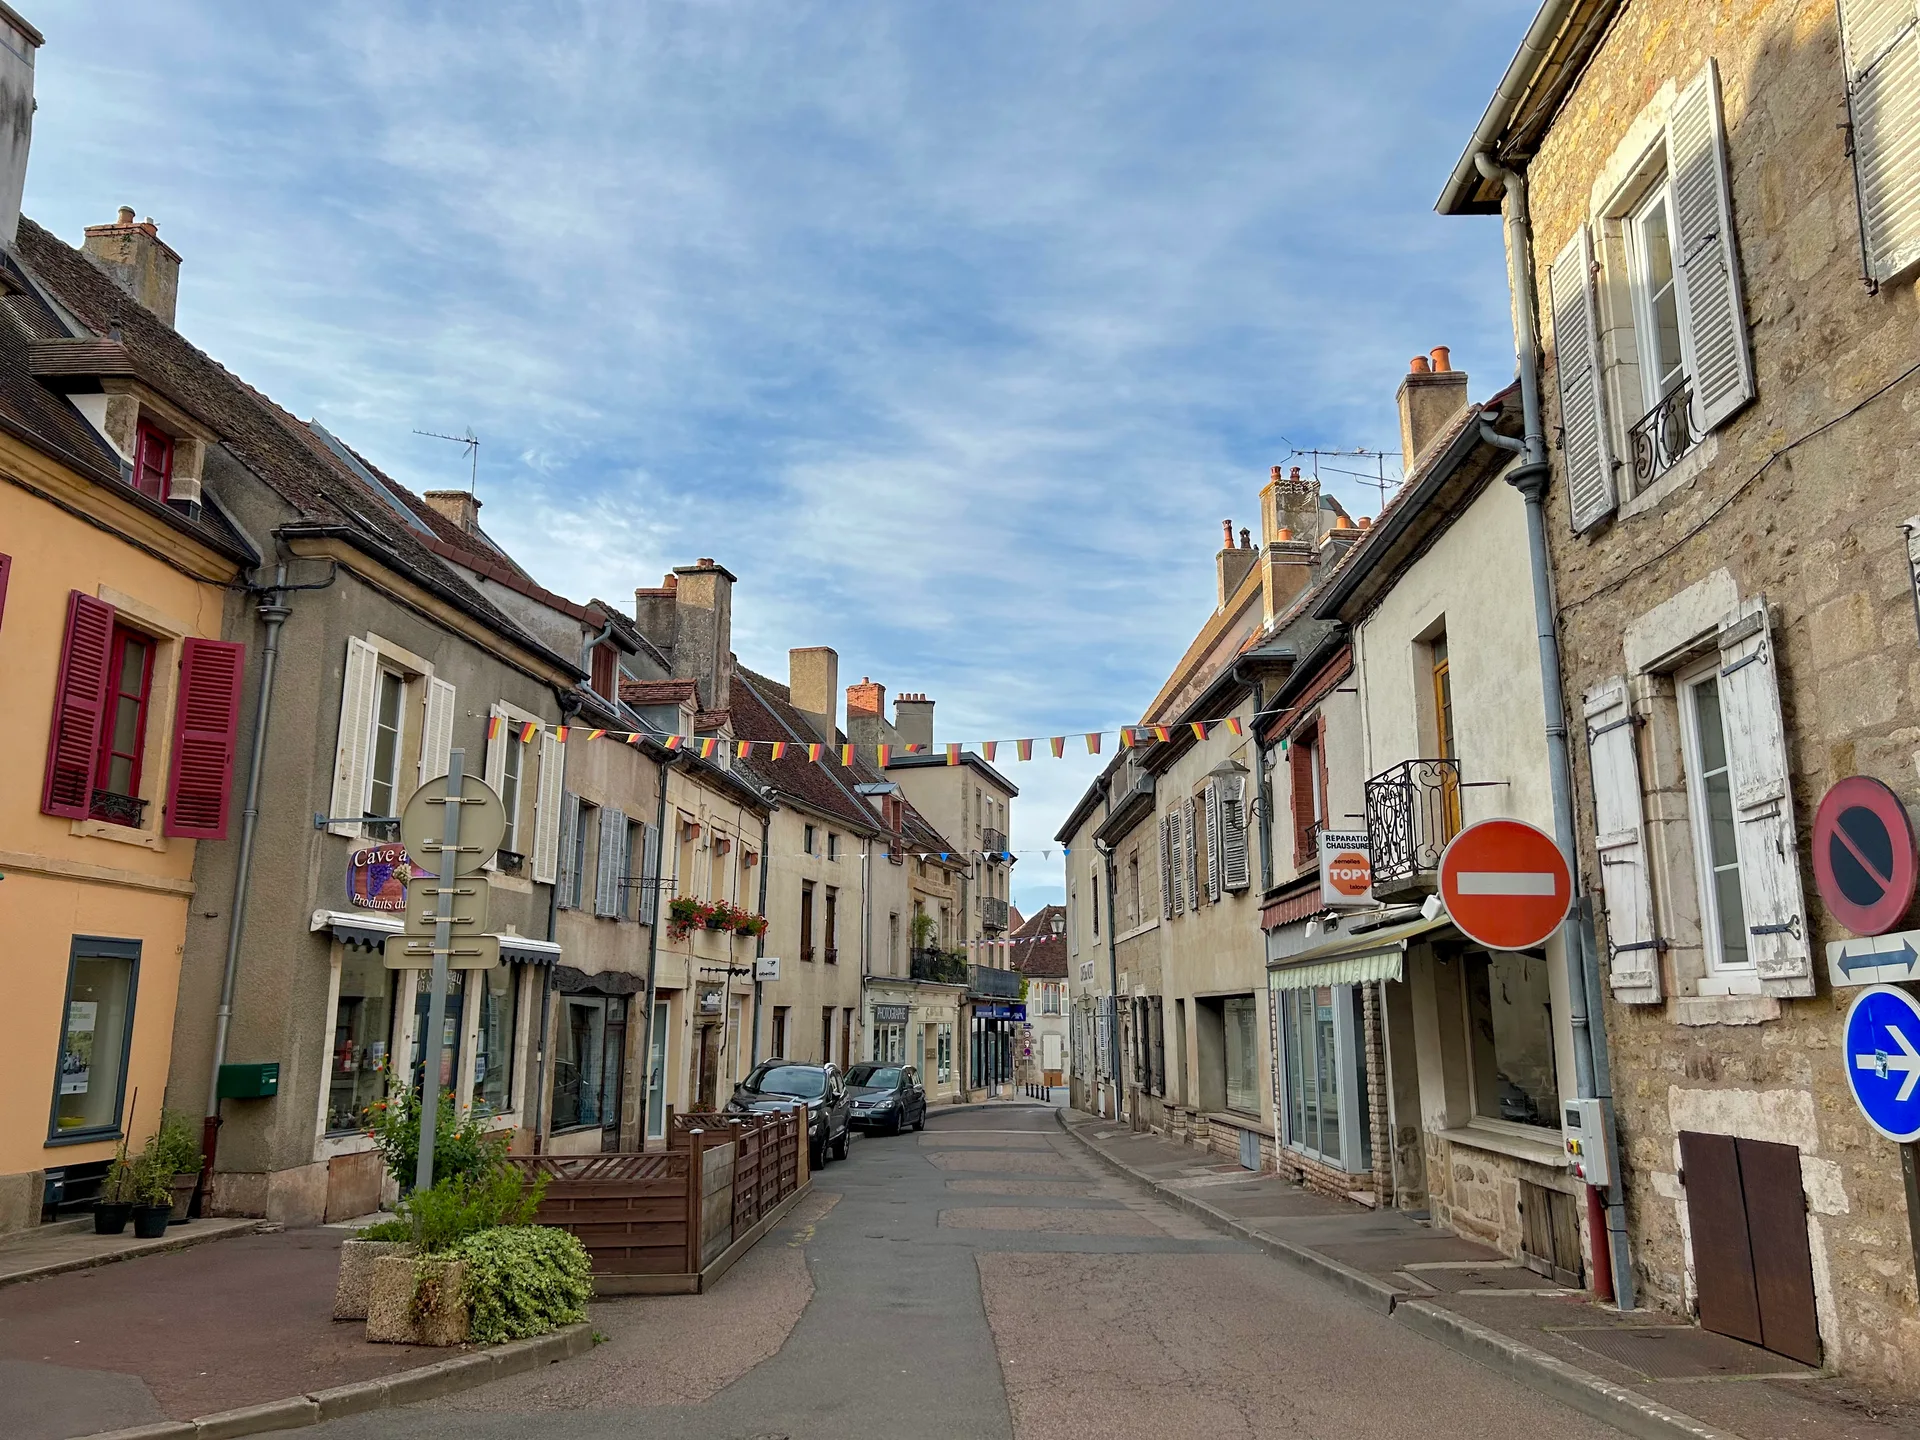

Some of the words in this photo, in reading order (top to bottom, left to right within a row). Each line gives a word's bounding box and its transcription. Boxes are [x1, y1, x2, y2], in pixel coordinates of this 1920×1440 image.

[354, 849, 395, 867] Cave
[1329, 869, 1370, 881] TOPY
[352, 893, 392, 910] Produits
[394, 897, 407, 910] du
[876, 1005, 907, 1021] PHOTOGRAPHE
